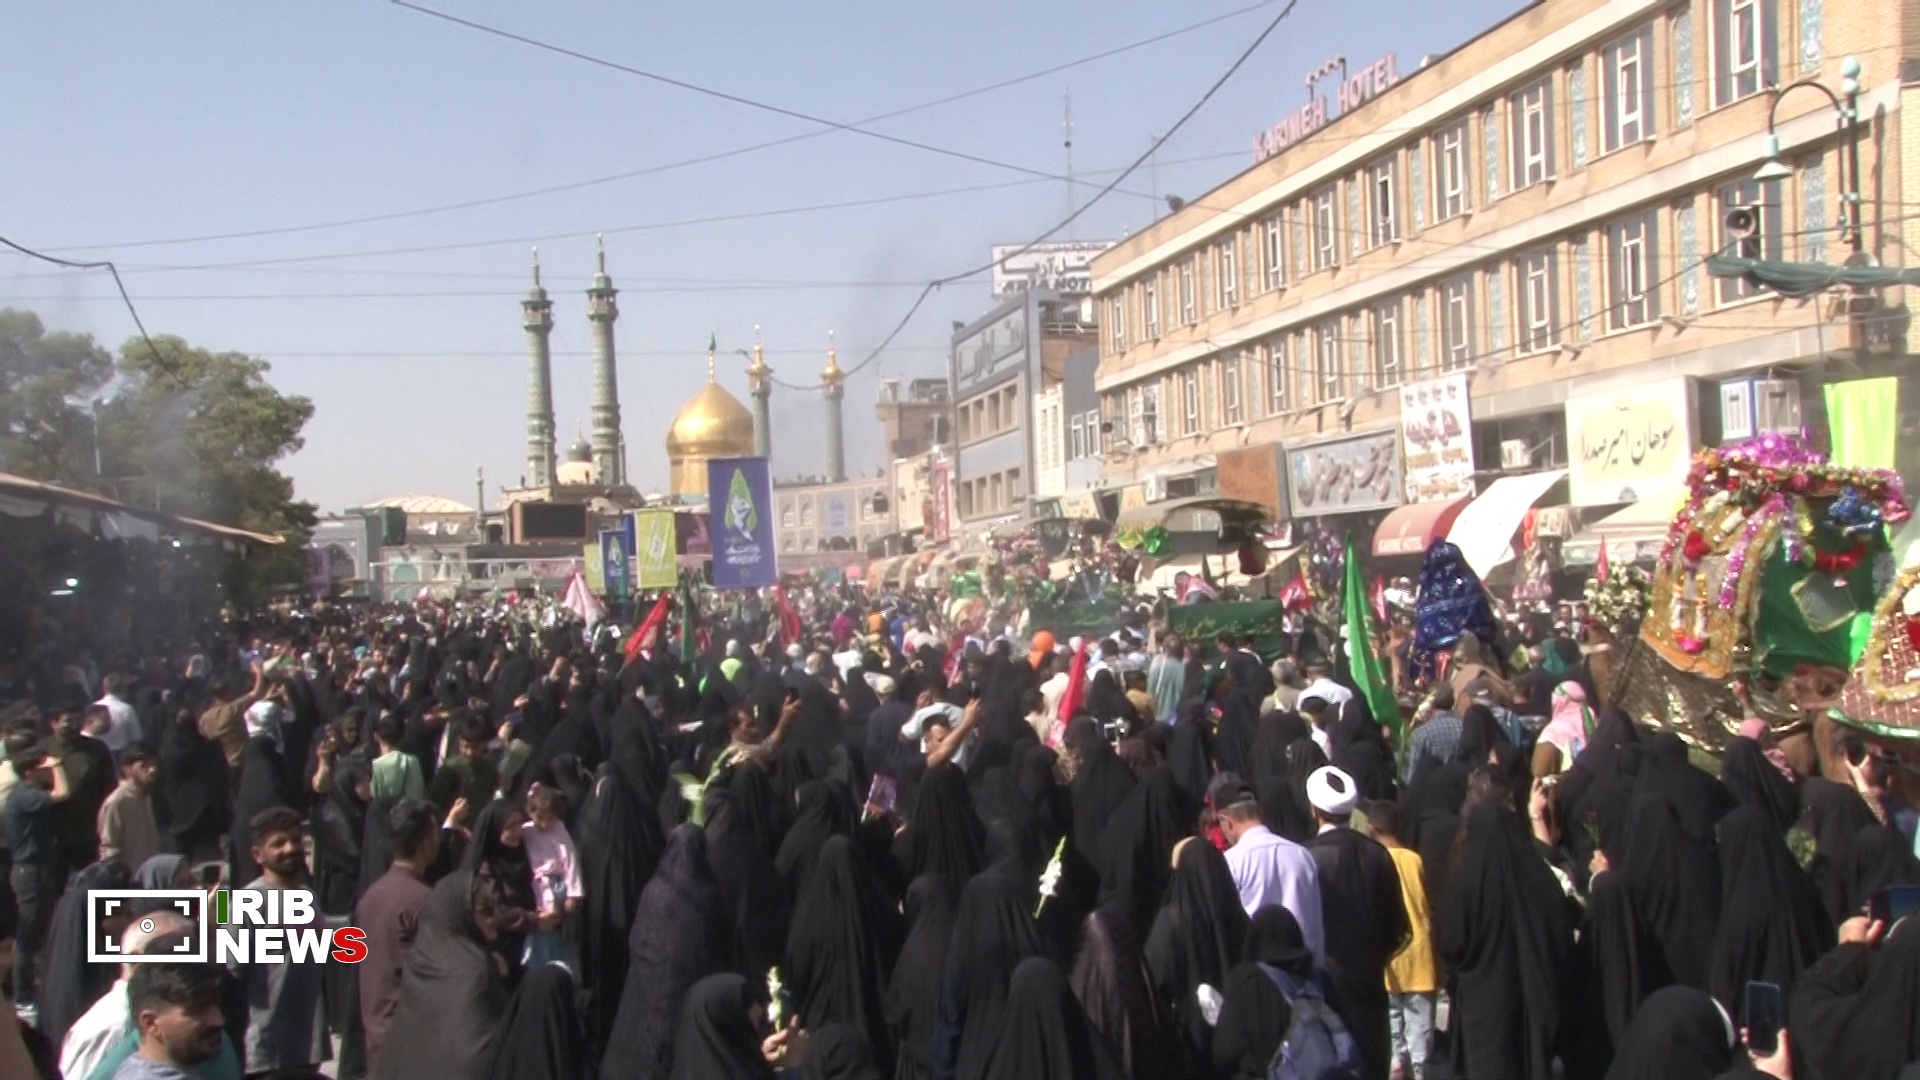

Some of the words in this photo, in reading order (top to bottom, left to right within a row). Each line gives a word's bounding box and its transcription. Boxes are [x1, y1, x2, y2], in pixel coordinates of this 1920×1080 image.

[1252, 95, 1327, 164] KARIMEH
[1337, 53, 1400, 113] HOTEL
[1055, 255, 1091, 275] تل
[1631, 420, 1675, 467] سوهان
